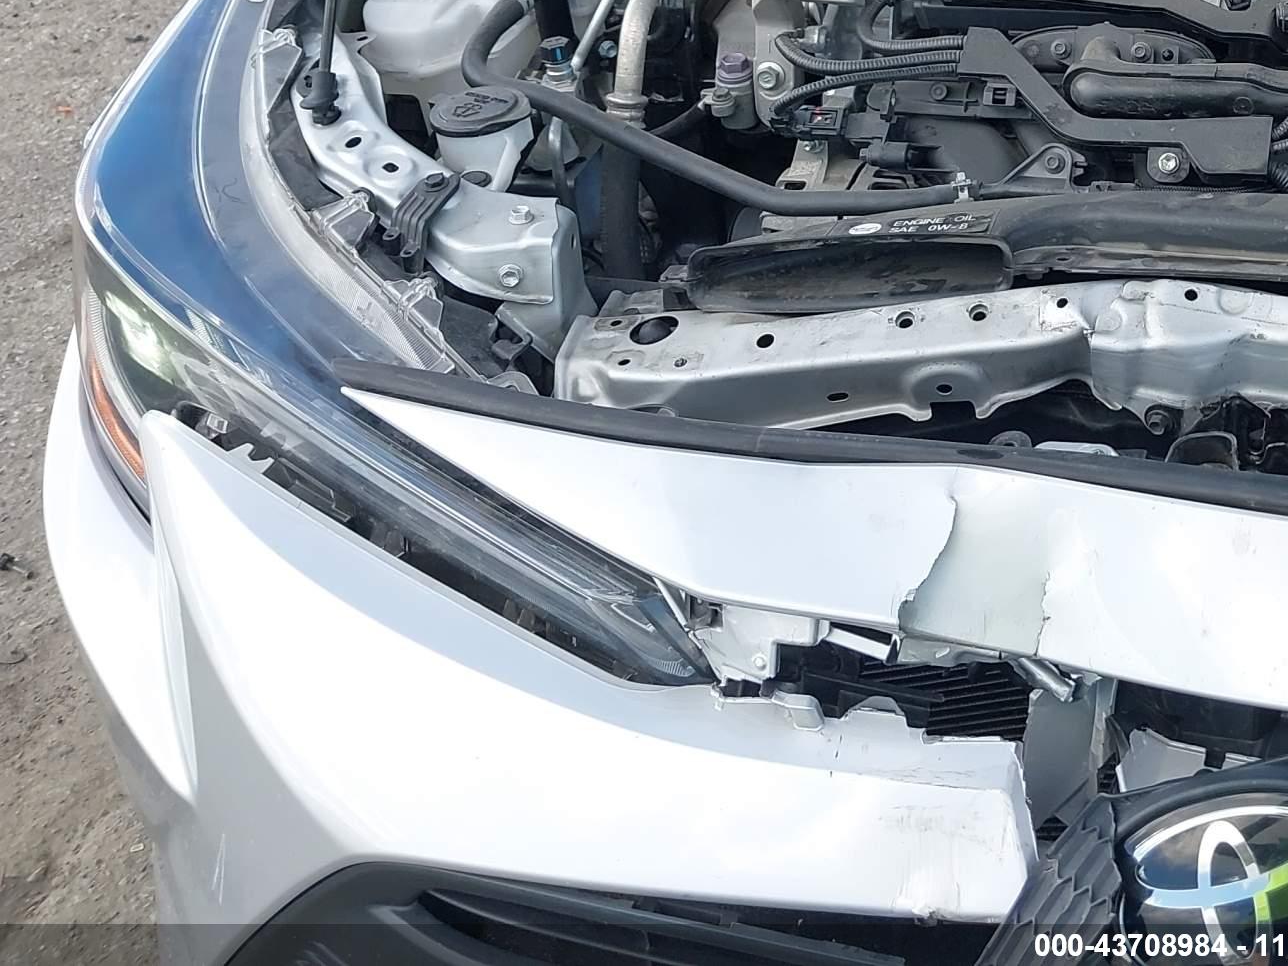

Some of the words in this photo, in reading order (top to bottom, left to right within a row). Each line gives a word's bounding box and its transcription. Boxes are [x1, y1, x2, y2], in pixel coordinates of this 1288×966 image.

[893, 218, 945, 226] ENGINE
[954, 214, 976, 223] OIL
[888, 225, 919, 233] SAE
